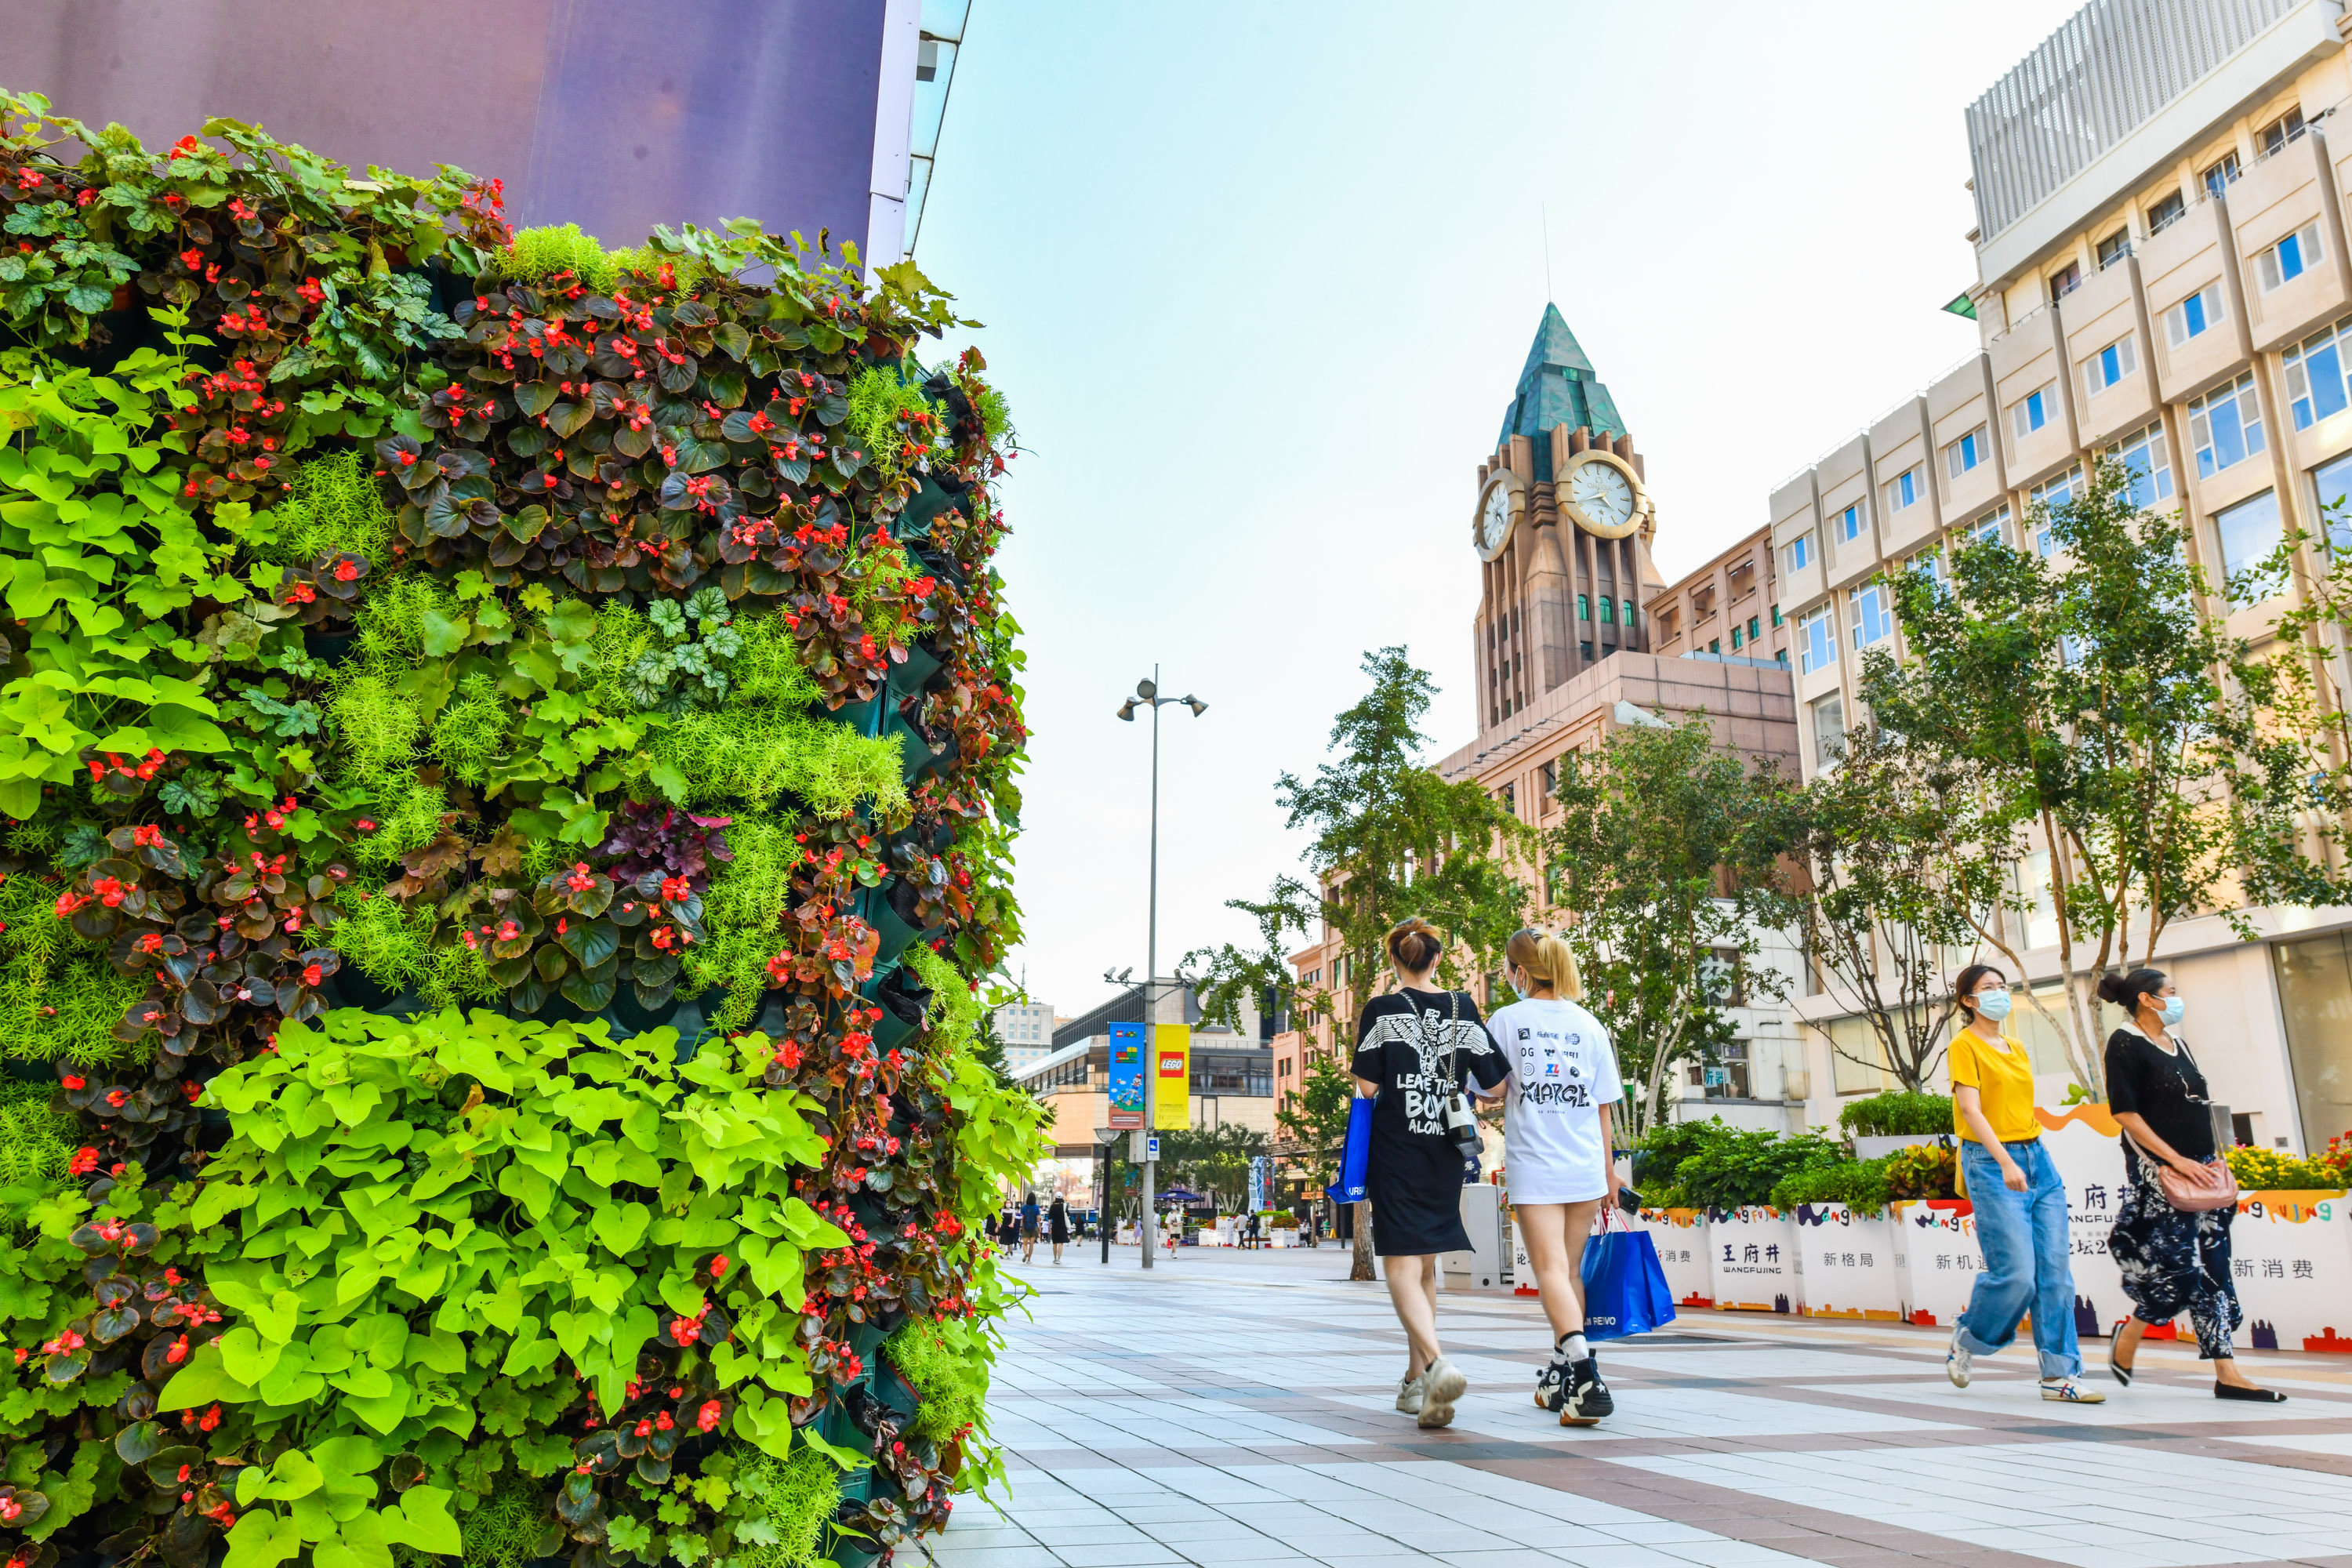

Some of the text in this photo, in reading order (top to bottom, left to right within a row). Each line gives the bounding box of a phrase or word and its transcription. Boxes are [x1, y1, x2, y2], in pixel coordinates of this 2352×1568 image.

[1521, 1047, 1534, 1057] OG
[1161, 1058, 1183, 1069] LEGO
[1545, 1064, 1559, 1074] XL
[1519, 1082, 1590, 1108] XLARGE
[1405, 1091, 1446, 1121] BOY
[1408, 1119, 1446, 1135] ALONE
[1722, 1243, 1780, 1264] 王府井
[1824, 1252, 1873, 1267] 新格局
[2233, 1258, 2314, 1279] 新消费
